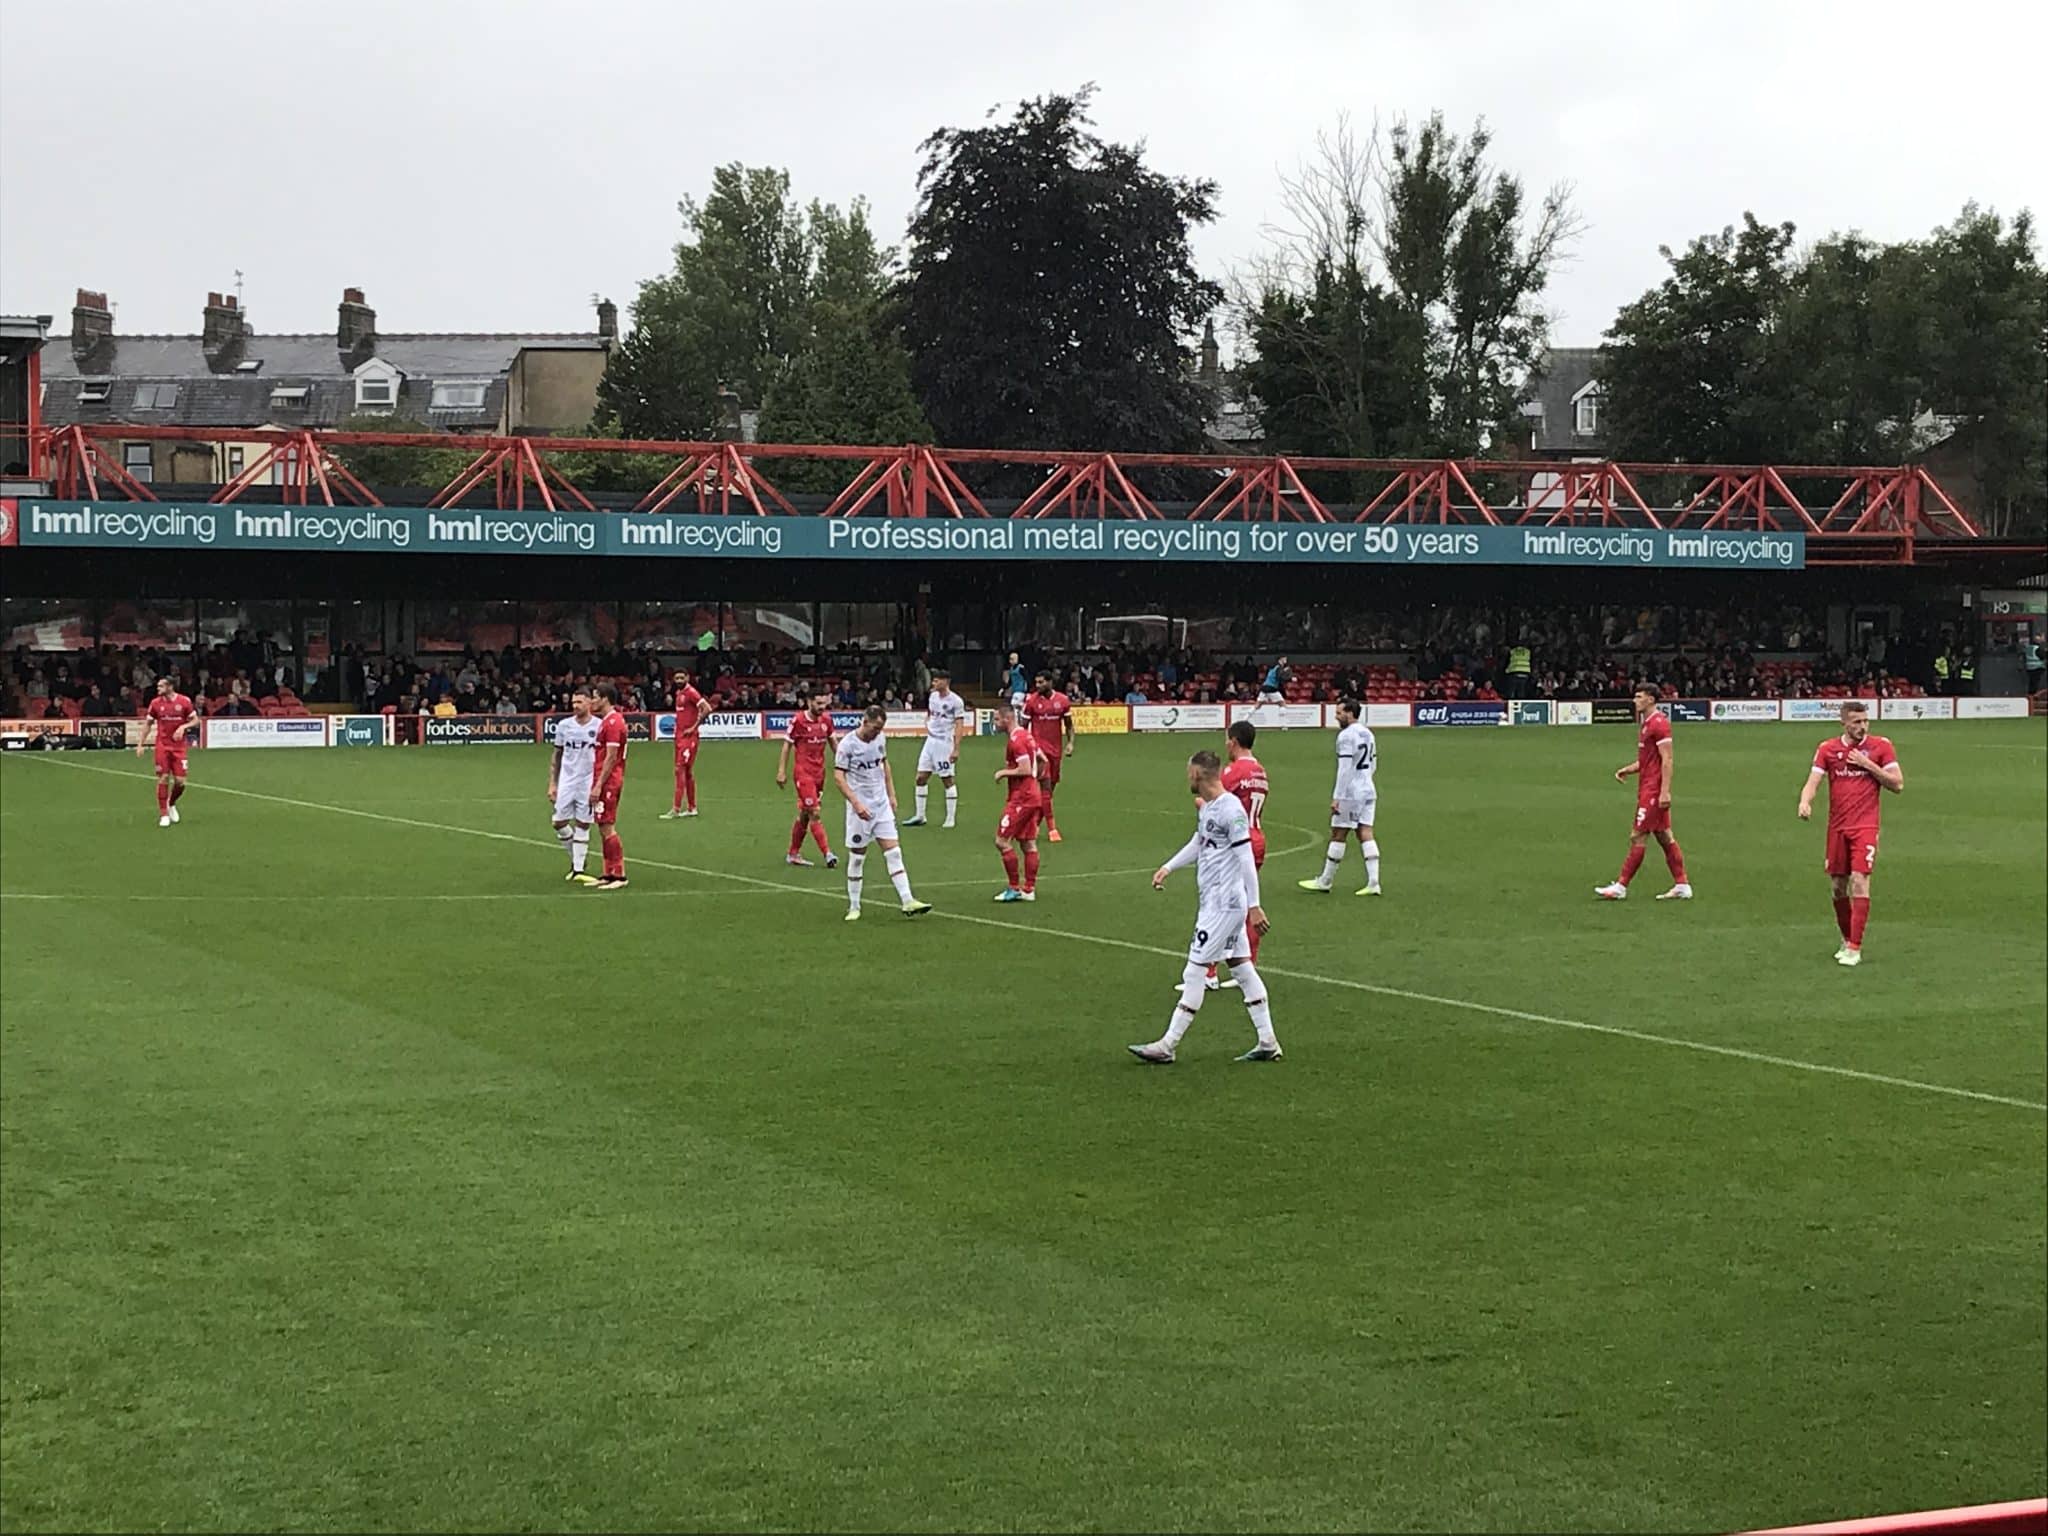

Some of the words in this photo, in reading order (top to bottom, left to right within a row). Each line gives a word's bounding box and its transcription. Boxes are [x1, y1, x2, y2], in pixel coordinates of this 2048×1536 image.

[829, 520, 1013, 549] Professional
[1024, 522, 1103, 550] metal
[1114, 524, 1240, 557] recycling
[1249, 526, 1288, 552] for
[1297, 531, 1356, 553] over
[1364, 527, 1398, 553] 50
[1406, 533, 1479, 560] years
[210, 722, 229, 732] TG
[231, 722, 273, 732] BAKER
[703, 714, 757, 726] ARVIEW
[348, 727, 371, 739] hml
[682, 748, 690, 763] 4
[1001, 814, 1010, 828] 6
[1637, 807, 1647, 821] 5
[1865, 845, 1875, 862] 2
